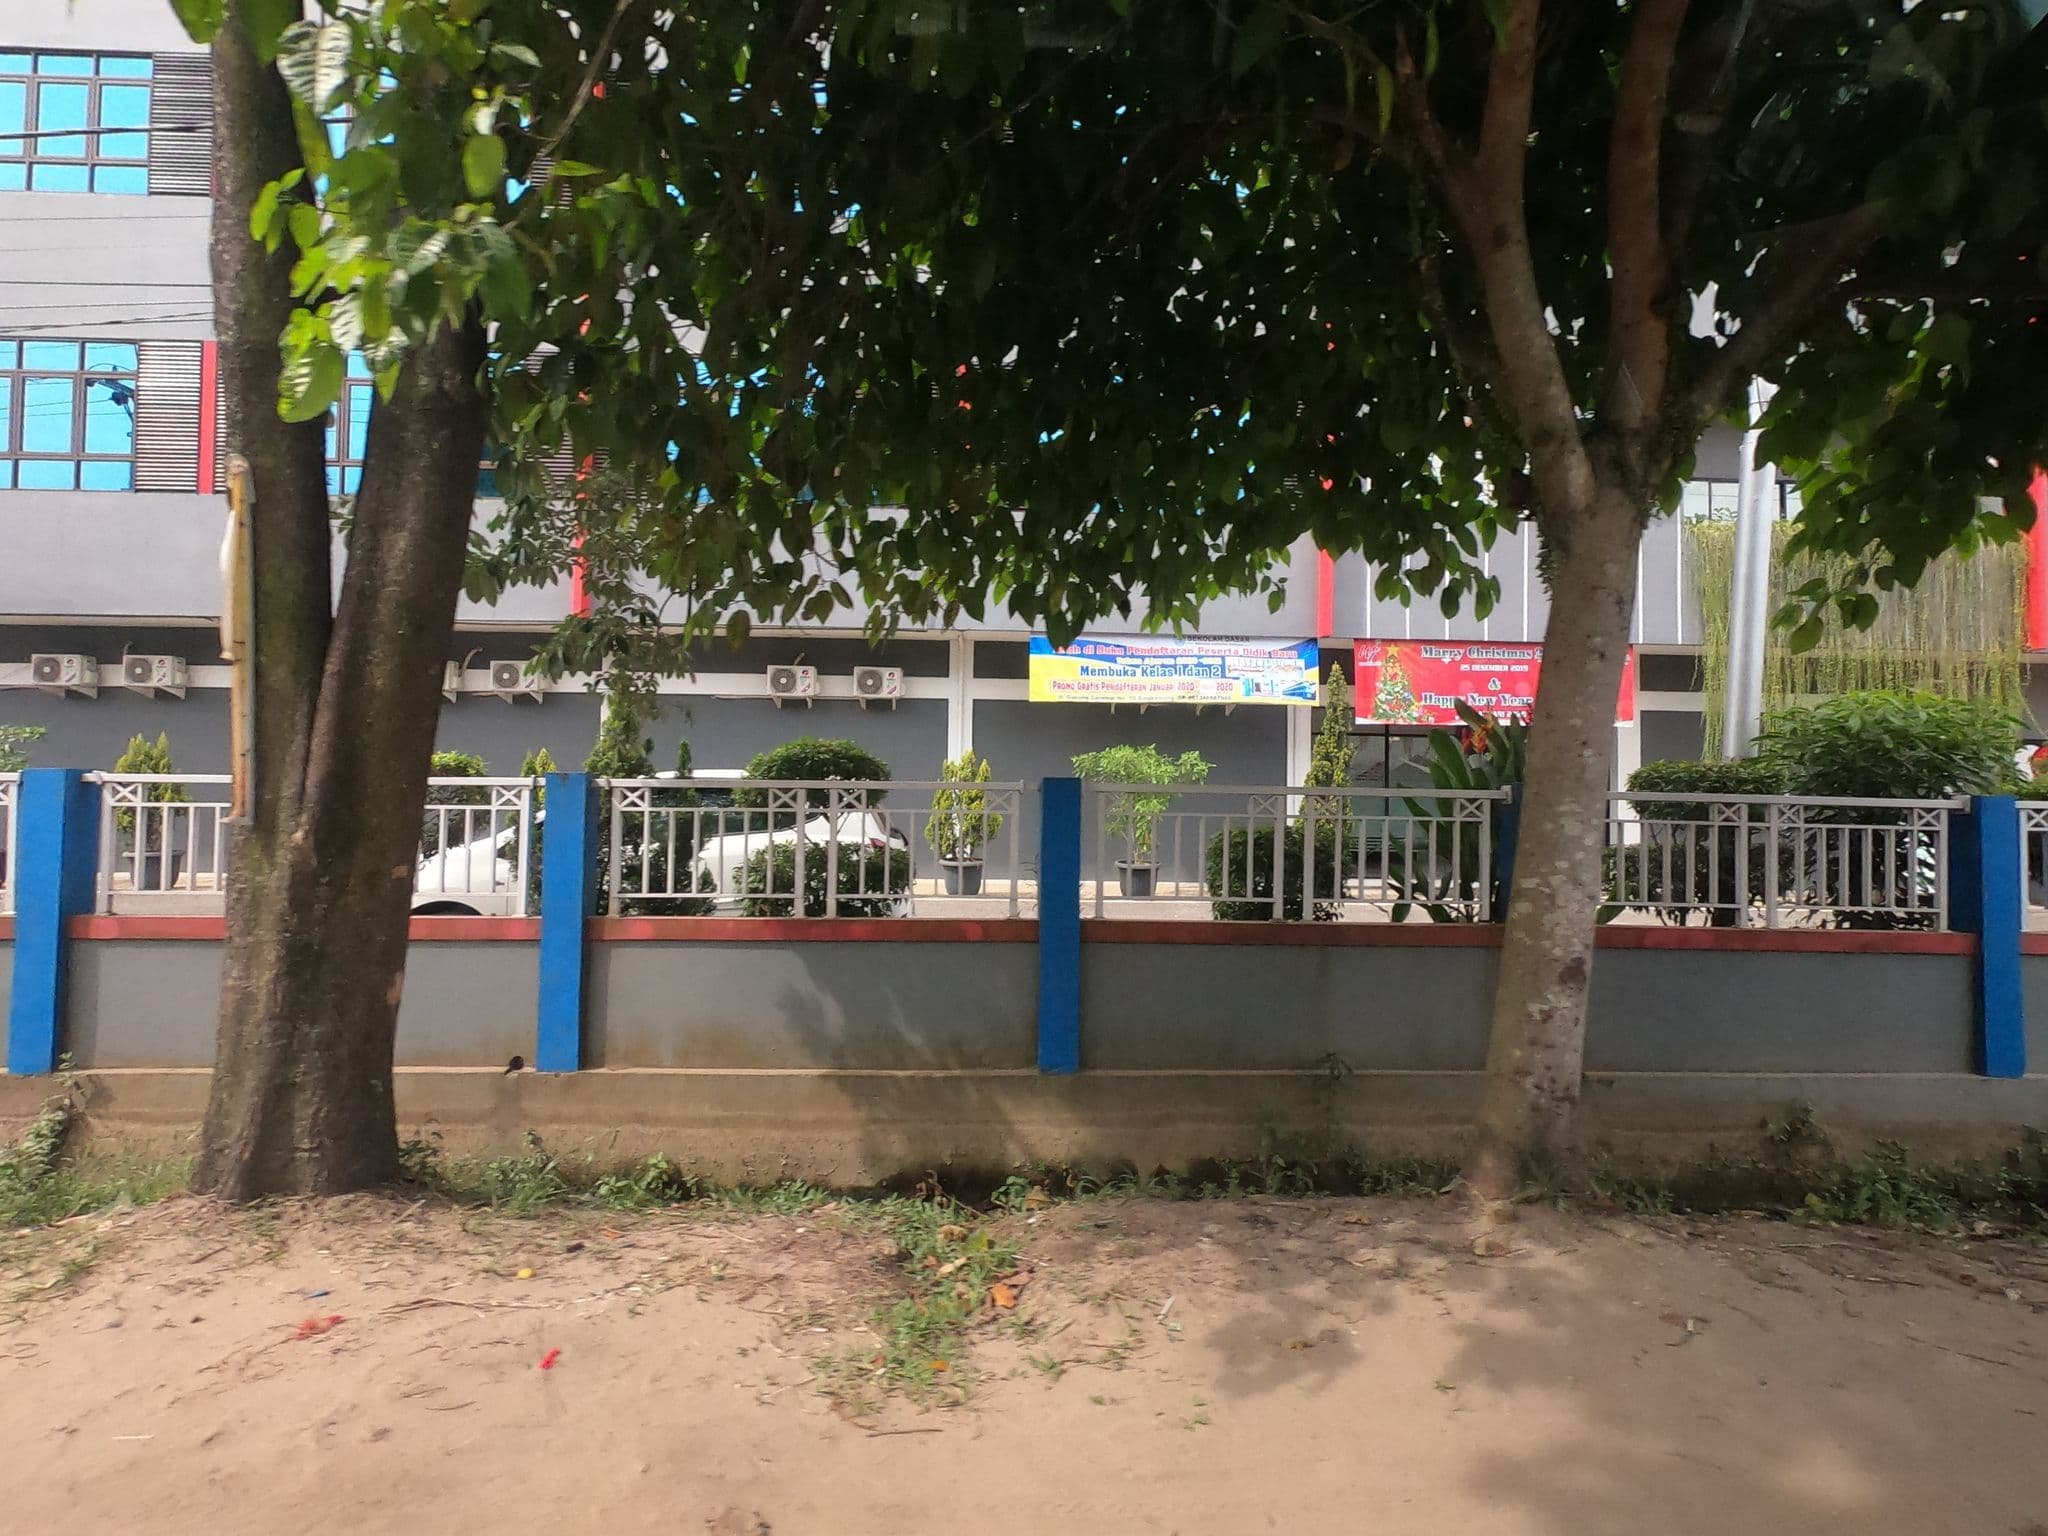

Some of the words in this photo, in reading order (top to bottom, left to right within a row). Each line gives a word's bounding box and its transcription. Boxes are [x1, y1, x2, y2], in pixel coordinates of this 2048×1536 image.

[1096, 645, 1124, 656] Buka
[1126, 645, 1194, 656] Pendaftaran
[1197, 646, 1239, 657] Peserta
[1242, 648, 1268, 657] Didik
[1421, 645, 1465, 661] Marry
[1466, 646, 1533, 660] Christmas
[1080, 665, 1136, 677] Membuka
[1141, 666, 1174, 678] Kelas
[1186, 666, 1209, 678] dan
[1212, 666, 1221, 678] 2
[1177, 681, 1195, 691] 2020
[1216, 682, 1233, 692] 2020
[1488, 677, 1501, 690] &
[1467, 693, 1497, 706] New
[1498, 693, 1534, 707] Year
